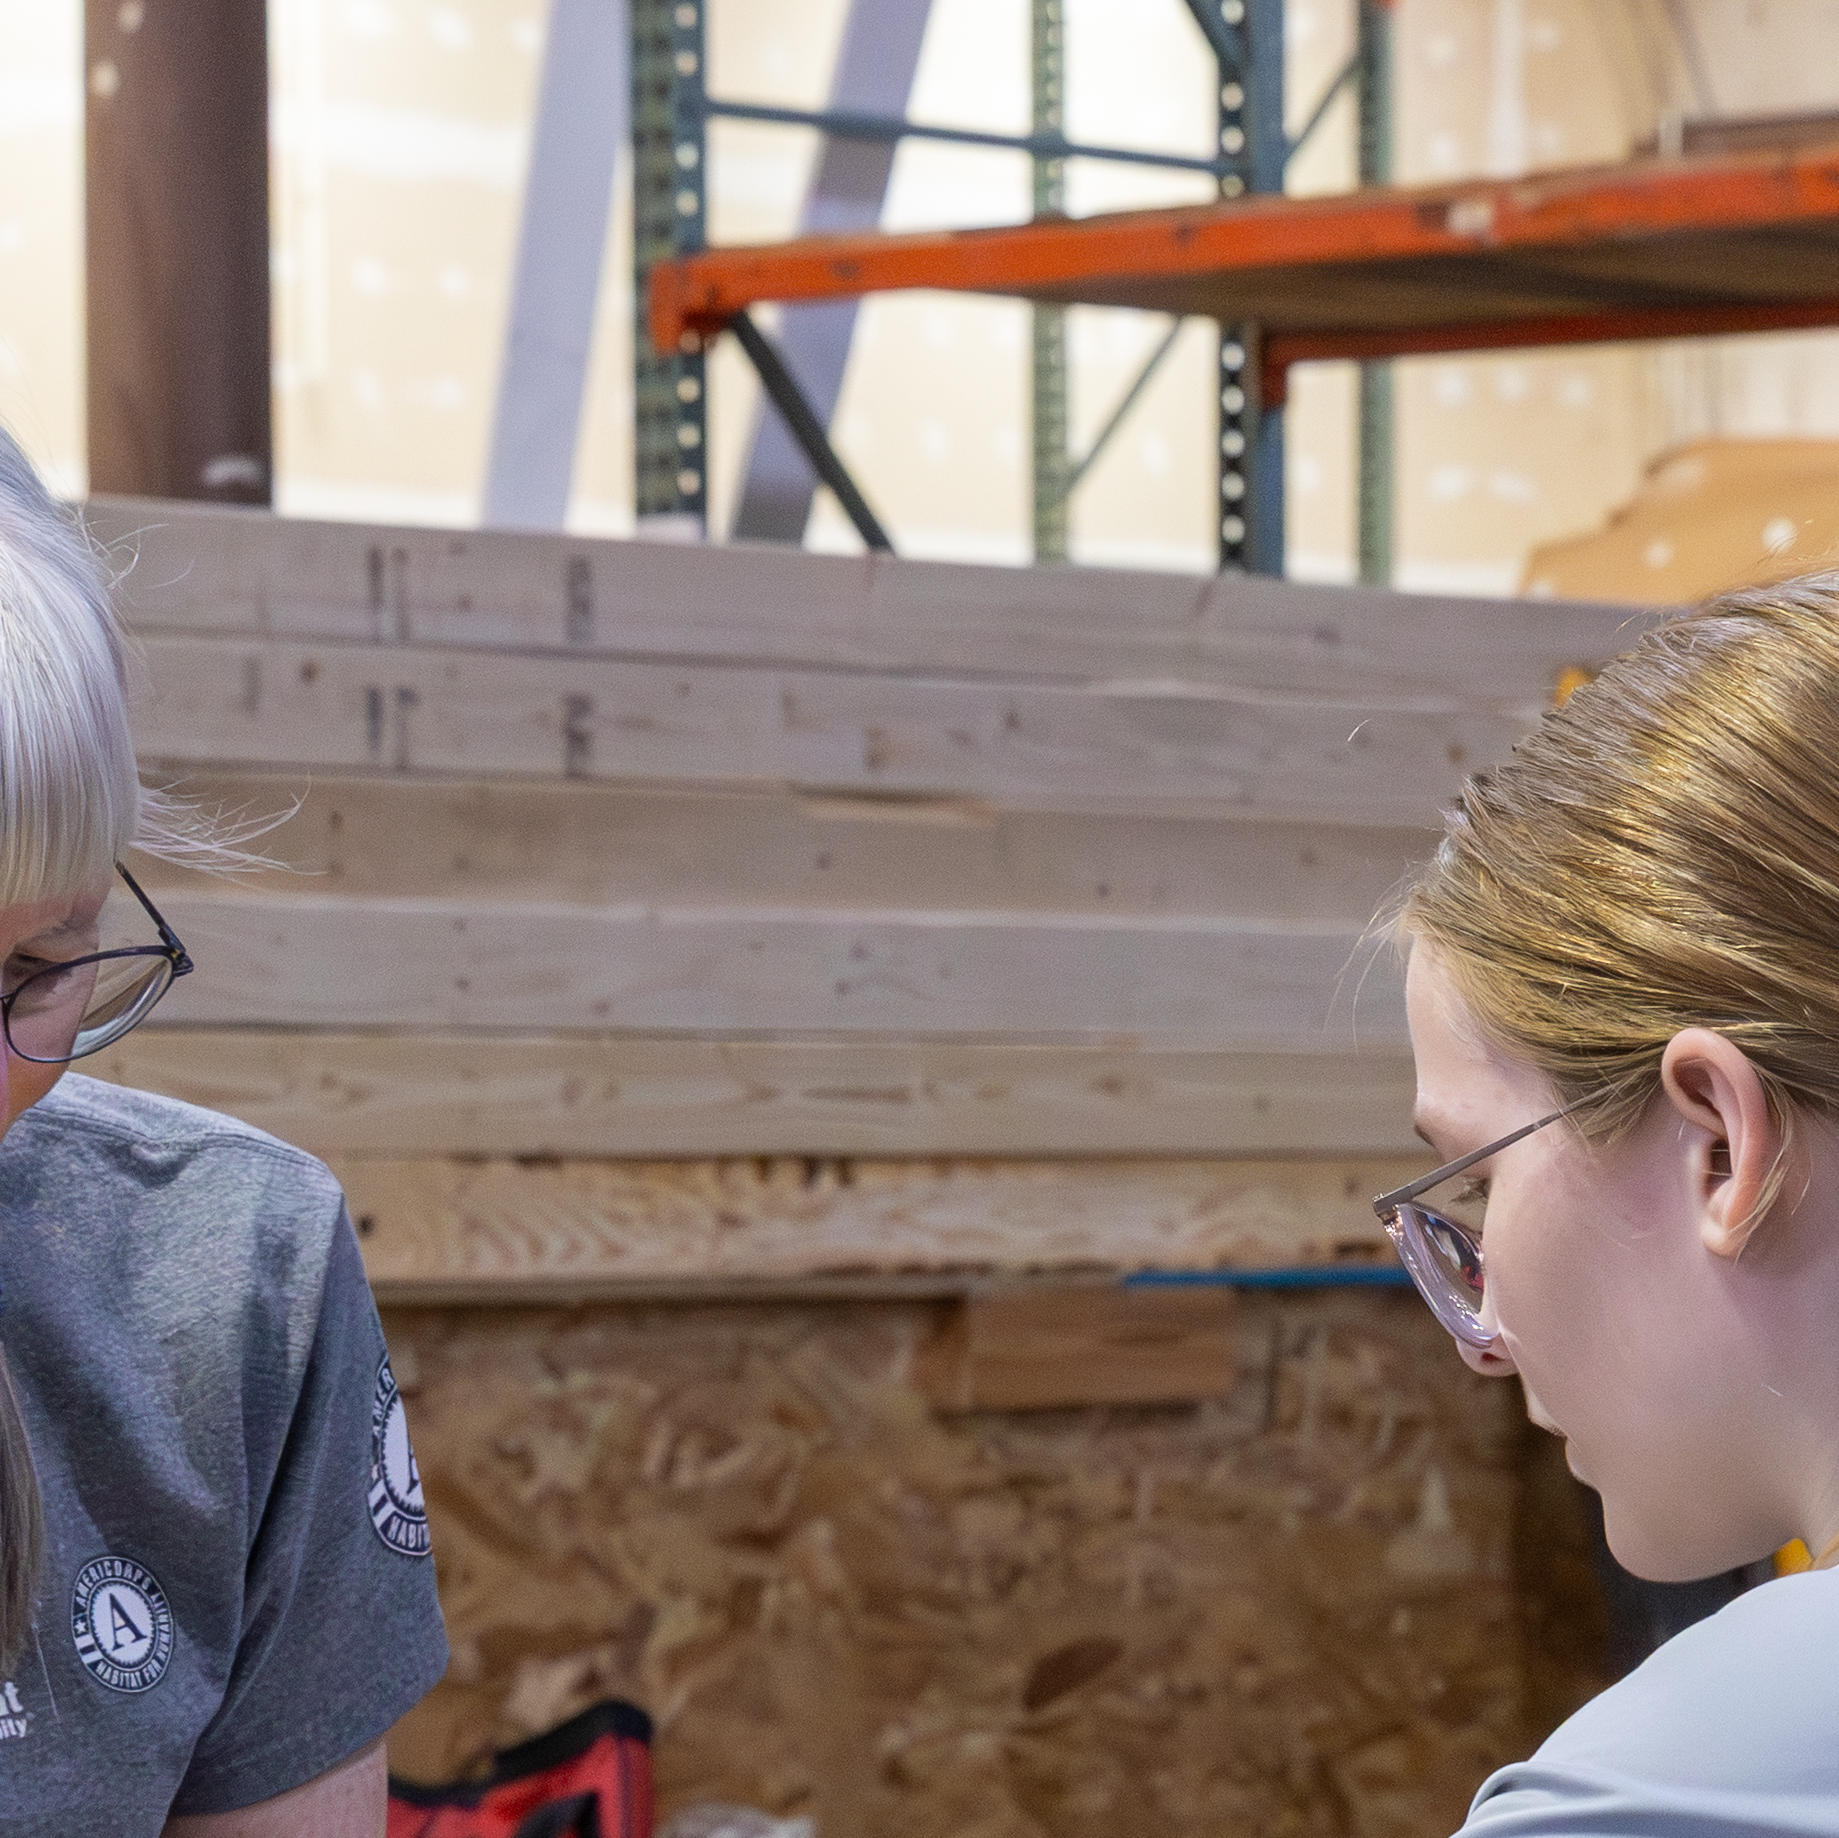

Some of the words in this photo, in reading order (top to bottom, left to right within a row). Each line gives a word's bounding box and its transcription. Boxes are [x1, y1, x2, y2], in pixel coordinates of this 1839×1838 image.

[75, 1560, 153, 1607] AMERICORPS
[108, 1592, 149, 1651] A
[96, 1660, 142, 1688] HABITAT
[142, 1658, 163, 1683] FOR
